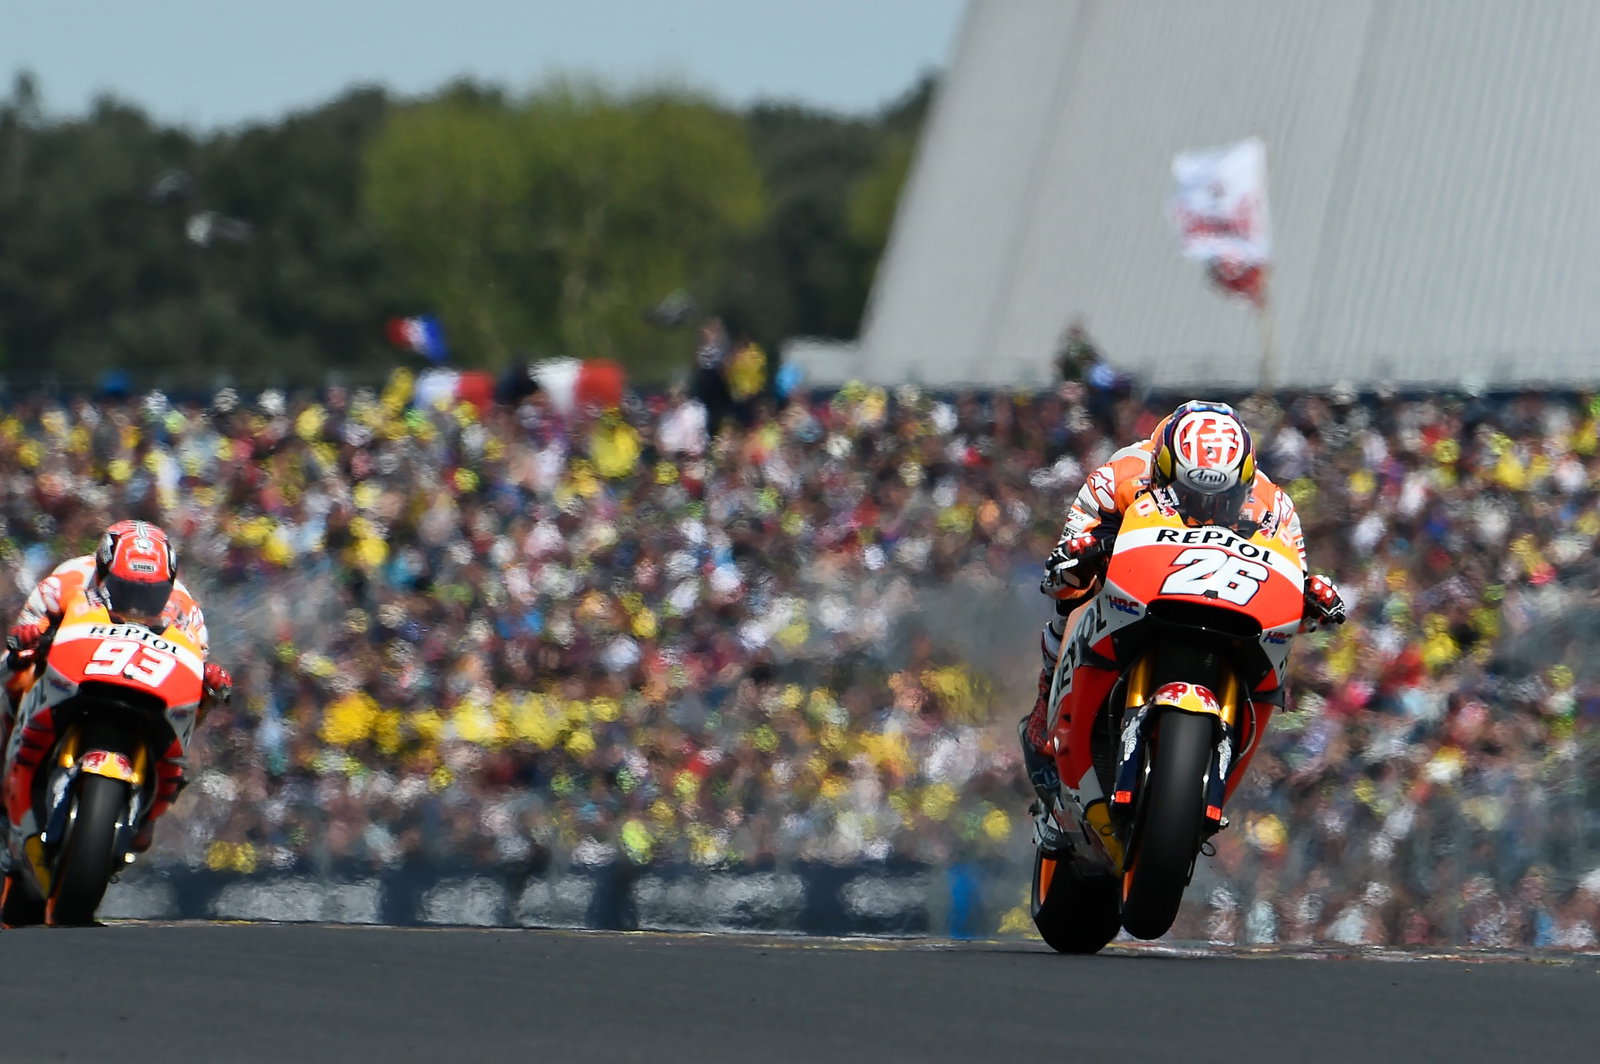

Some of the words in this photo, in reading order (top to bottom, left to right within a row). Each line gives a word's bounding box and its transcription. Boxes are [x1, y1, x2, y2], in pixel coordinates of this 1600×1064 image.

[1156, 529, 1273, 566] REPSOL
[1157, 547, 1270, 606] 26
[83, 639, 178, 688] 93
